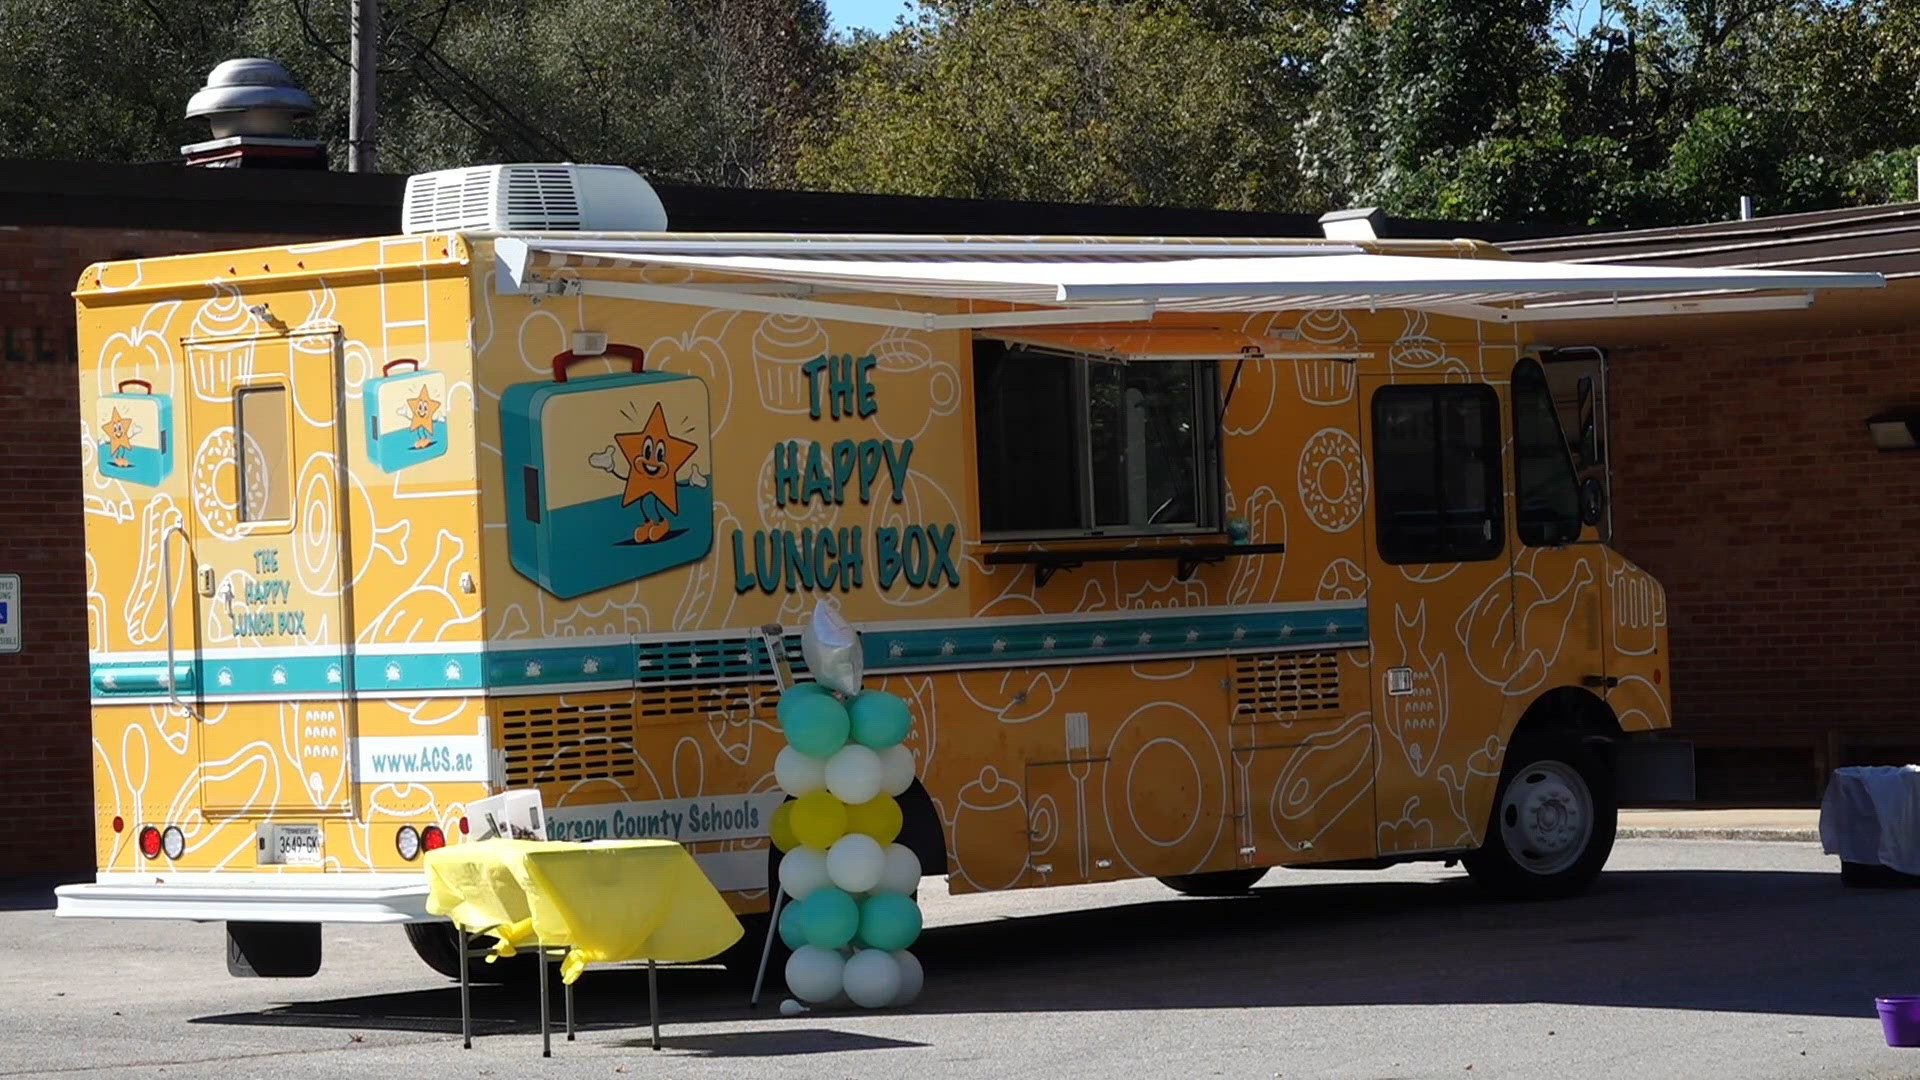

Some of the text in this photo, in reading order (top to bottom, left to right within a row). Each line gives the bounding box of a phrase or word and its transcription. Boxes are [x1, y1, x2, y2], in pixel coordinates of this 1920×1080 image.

[802, 352, 877, 420] THE
[774, 438, 914, 506] HAPPY
[253, 548, 279, 574] THE
[731, 522, 960, 595] LUNCH BOX
[245, 579, 291, 606] HAPPY
[232, 610, 306, 637] LUNCH BOX
[371, 746, 473, 773] www.ACS.ac
[612, 809, 684, 839] County
[688, 800, 759, 833] Schools
